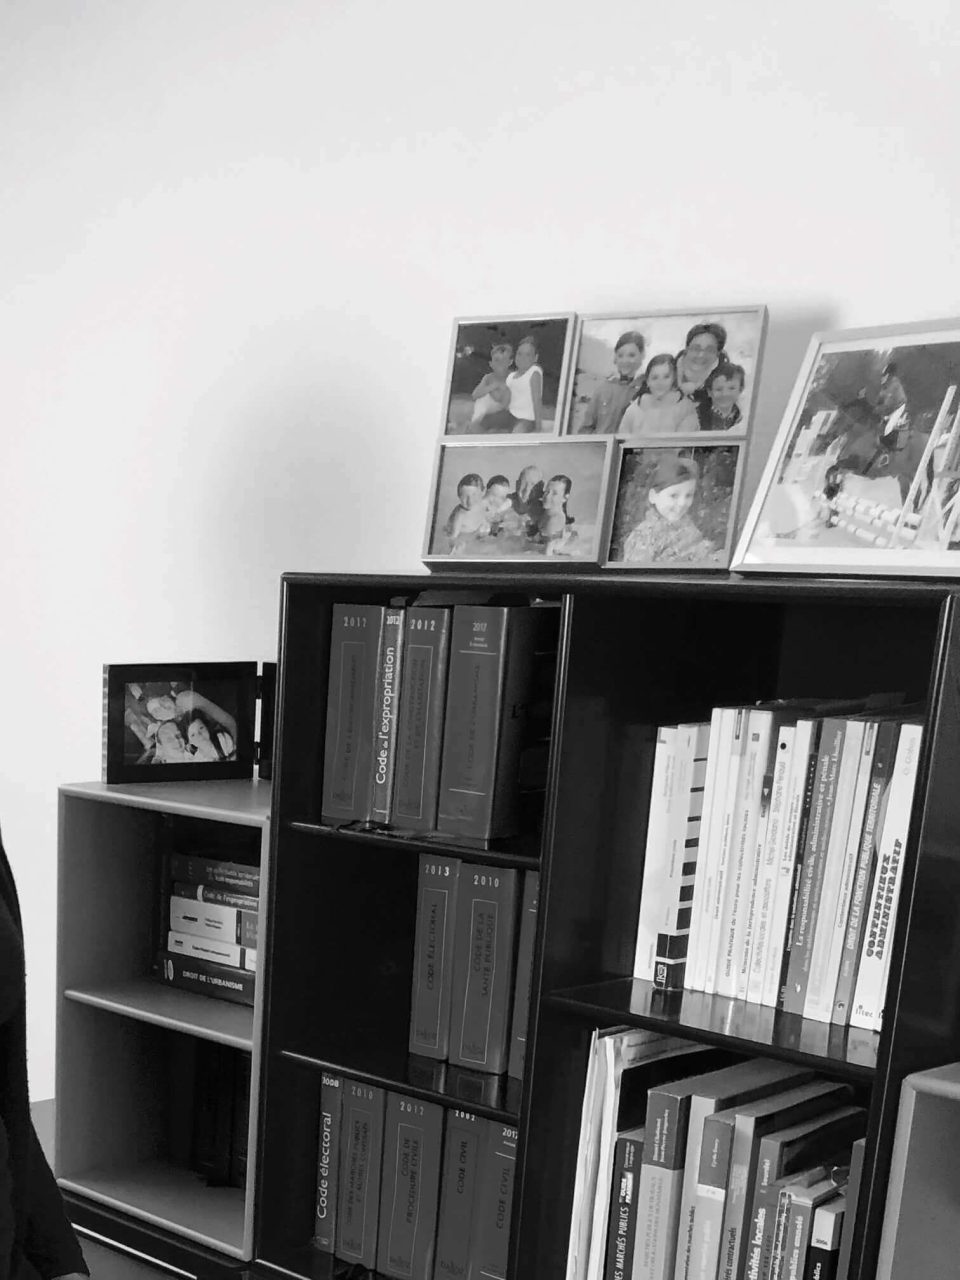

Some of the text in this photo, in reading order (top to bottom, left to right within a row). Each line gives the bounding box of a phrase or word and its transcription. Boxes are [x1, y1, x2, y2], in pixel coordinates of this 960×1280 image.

[410, 619, 435, 631] 2012
[379, 647, 394, 739] l'expropriation
[375, 750, 387, 784] Code
[818, 782, 826, 792] et
[809, 794, 825, 851] administrative
[425, 864, 449, 876] 2013
[473, 874, 499, 888] 2010
[847, 782, 881, 950] DROIT DE LA FONCTION PUBLIQUE TERRITORIALE
[798, 878, 812, 934] responsabilité
[865, 853, 892, 958] CONTENTIEUX
[874, 838, 904, 961] ADMINISTRATIF
[474, 912, 484, 972] CODE DE LA
[795, 936, 804, 947] La
[199, 974, 206, 982] DE
[400, 1101, 424, 1116] 2012
[404, 1137, 410, 1150] DE
[317, 1111, 331, 1220] Code électoral
[456, 1139, 468, 1195] CODE CIVIL
[496, 1167, 511, 1231] CODE CIVIL
[619, 1205, 629, 1236] PUBLICS
[755, 1208, 766, 1247] locales
[618, 1236, 626, 1270] MARCHÉS
[727, 1226, 737, 1267] contractuels
